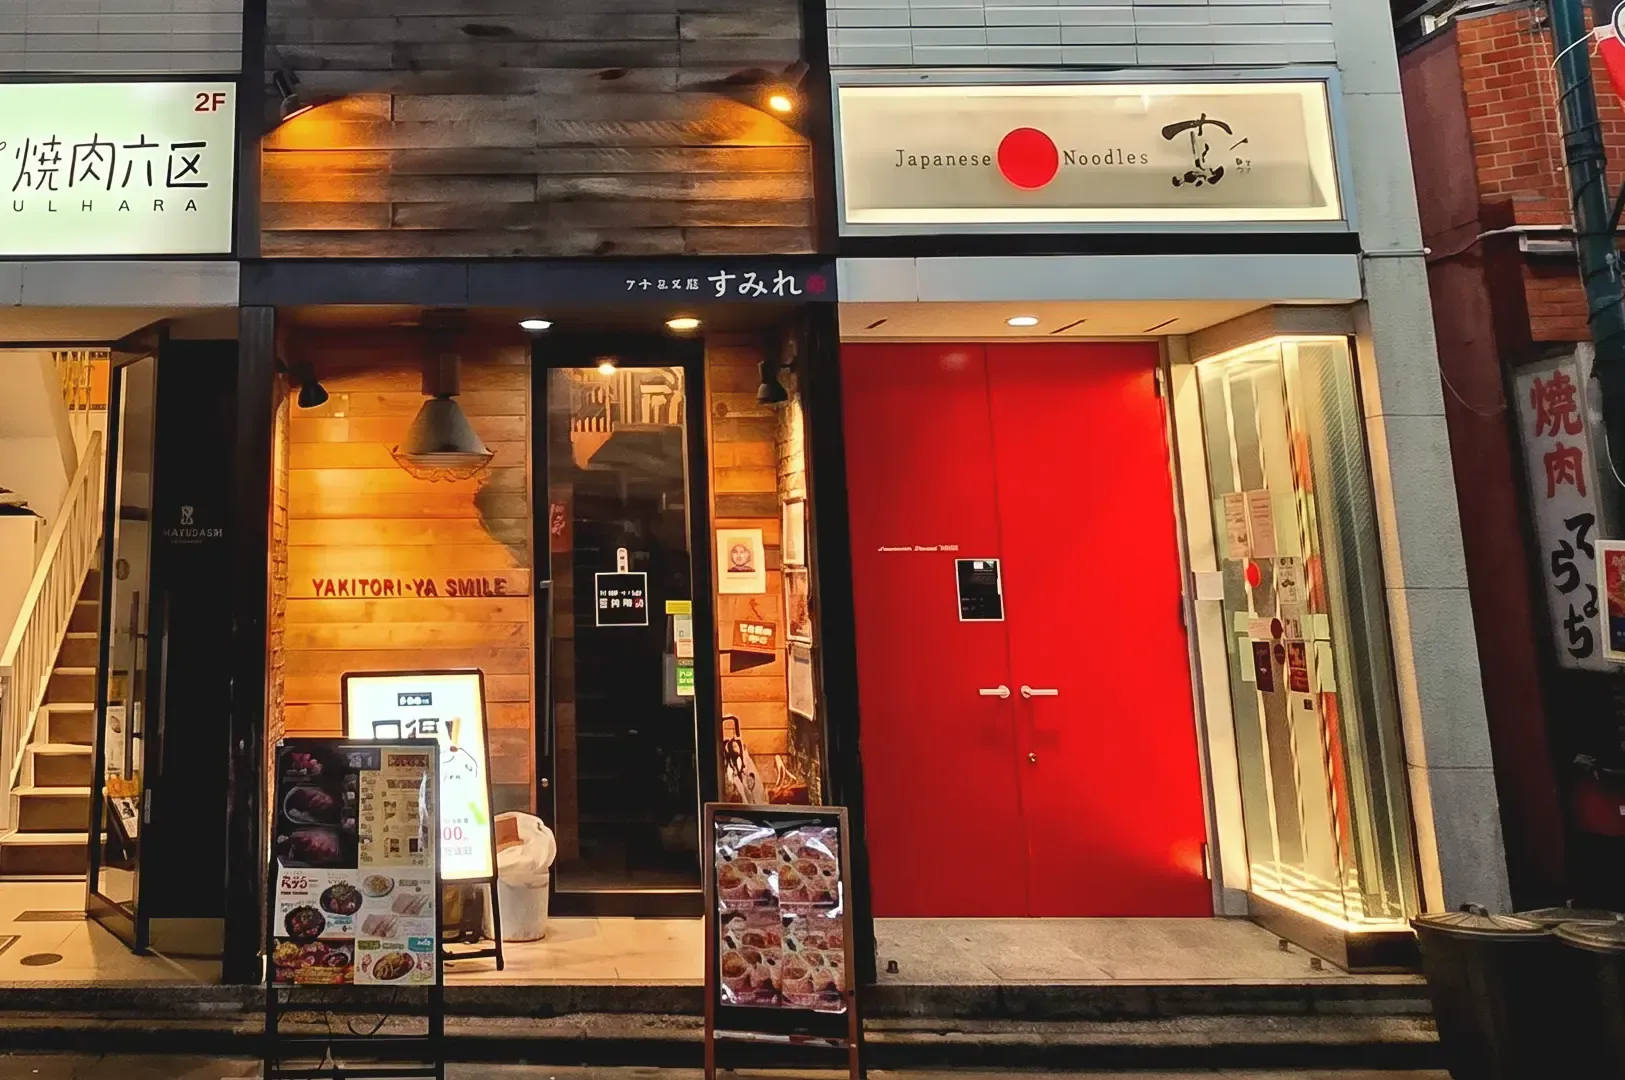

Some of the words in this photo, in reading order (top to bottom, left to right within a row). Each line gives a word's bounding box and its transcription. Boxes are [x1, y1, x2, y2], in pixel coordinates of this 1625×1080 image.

[194, 92, 227, 112] 2F
[895, 149, 992, 170] Japanese
[1063, 148, 1149, 166] Noodles
[707, 269, 803, 298] すみれ
[445, 577, 508, 597] SMILE
